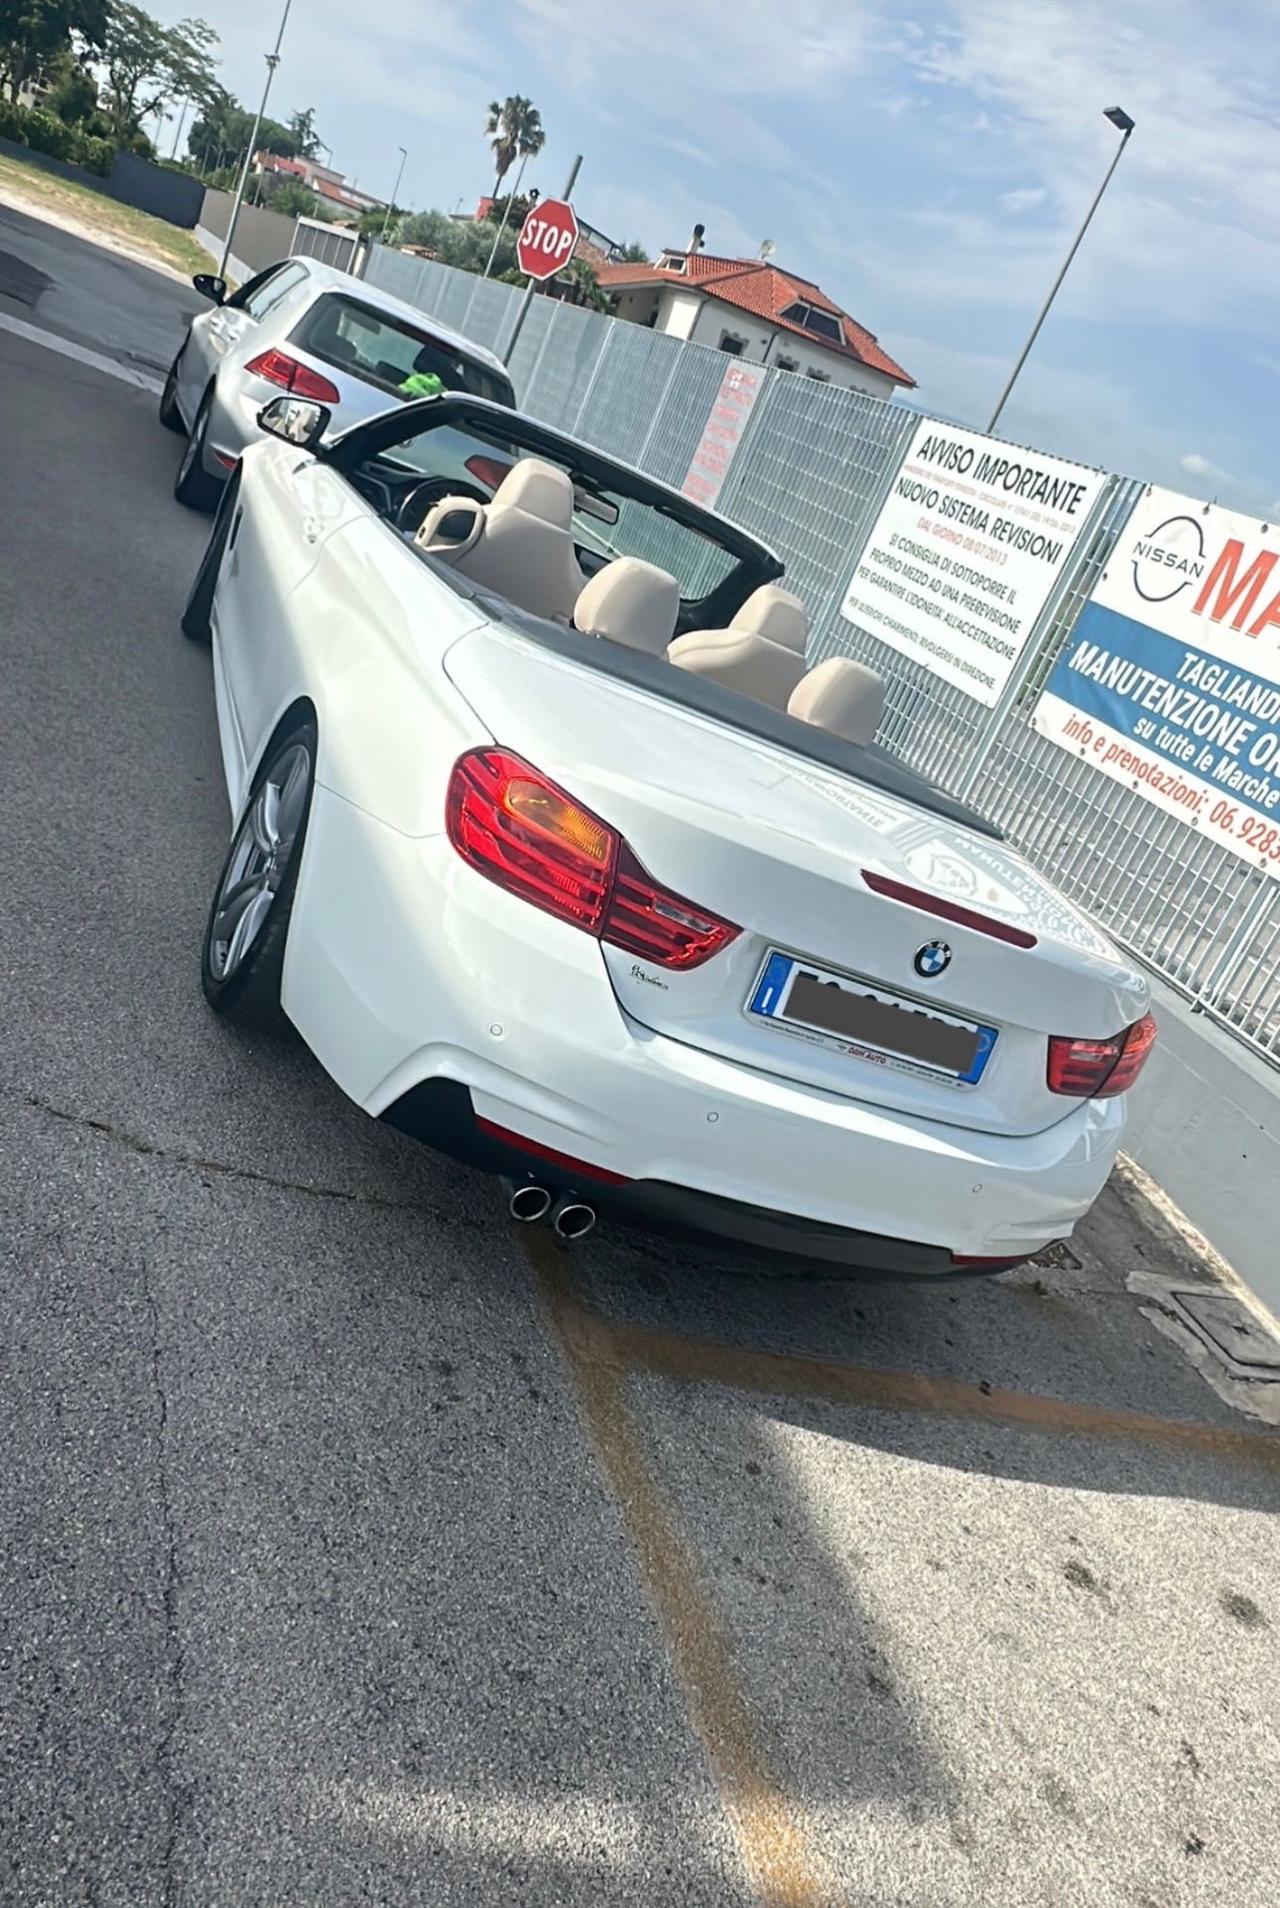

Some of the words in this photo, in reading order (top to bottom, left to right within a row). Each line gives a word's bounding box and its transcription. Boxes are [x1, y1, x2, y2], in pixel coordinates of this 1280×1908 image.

[522, 218, 574, 259] STOP
[917, 435, 974, 474] AVVISO
[973, 453, 1087, 514] IMPORTANTE
[895, 477, 939, 509] NUOVO
[938, 495, 990, 533] SISTEMA
[990, 518, 1063, 565] REVISIONI
[932, 523, 964, 545] GIORNO
[1133, 541, 1204, 579] NISSAN
[857, 565, 871, 580] PER
[869, 572, 907, 600] GARANTIRE
[869, 548, 902, 572] PROPRIO
[901, 563, 929, 586] MEZZO
[927, 578, 942, 593] AD
[941, 583, 961, 603] UNA
[961, 593, 1022, 634] PREREVISIONE
[889, 533, 899, 547] SI
[897, 537, 941, 568] CONSIGLIA
[940, 557, 952, 572] DI
[950, 562, 1008, 599] SOTTOPORRE
[1006, 589, 1017, 605] IL
[1068, 640, 1258, 756] MANUTENZIONE
[1062, 713, 1093, 745] info
[1093, 736, 1106, 752] e
[1101, 743, 1209, 814] prenotazioni:
[1133, 717, 1157, 740] su
[1155, 726, 1196, 761] tutte
[1193, 745, 1214, 772] le
[1212, 756, 1280, 809] Marche
